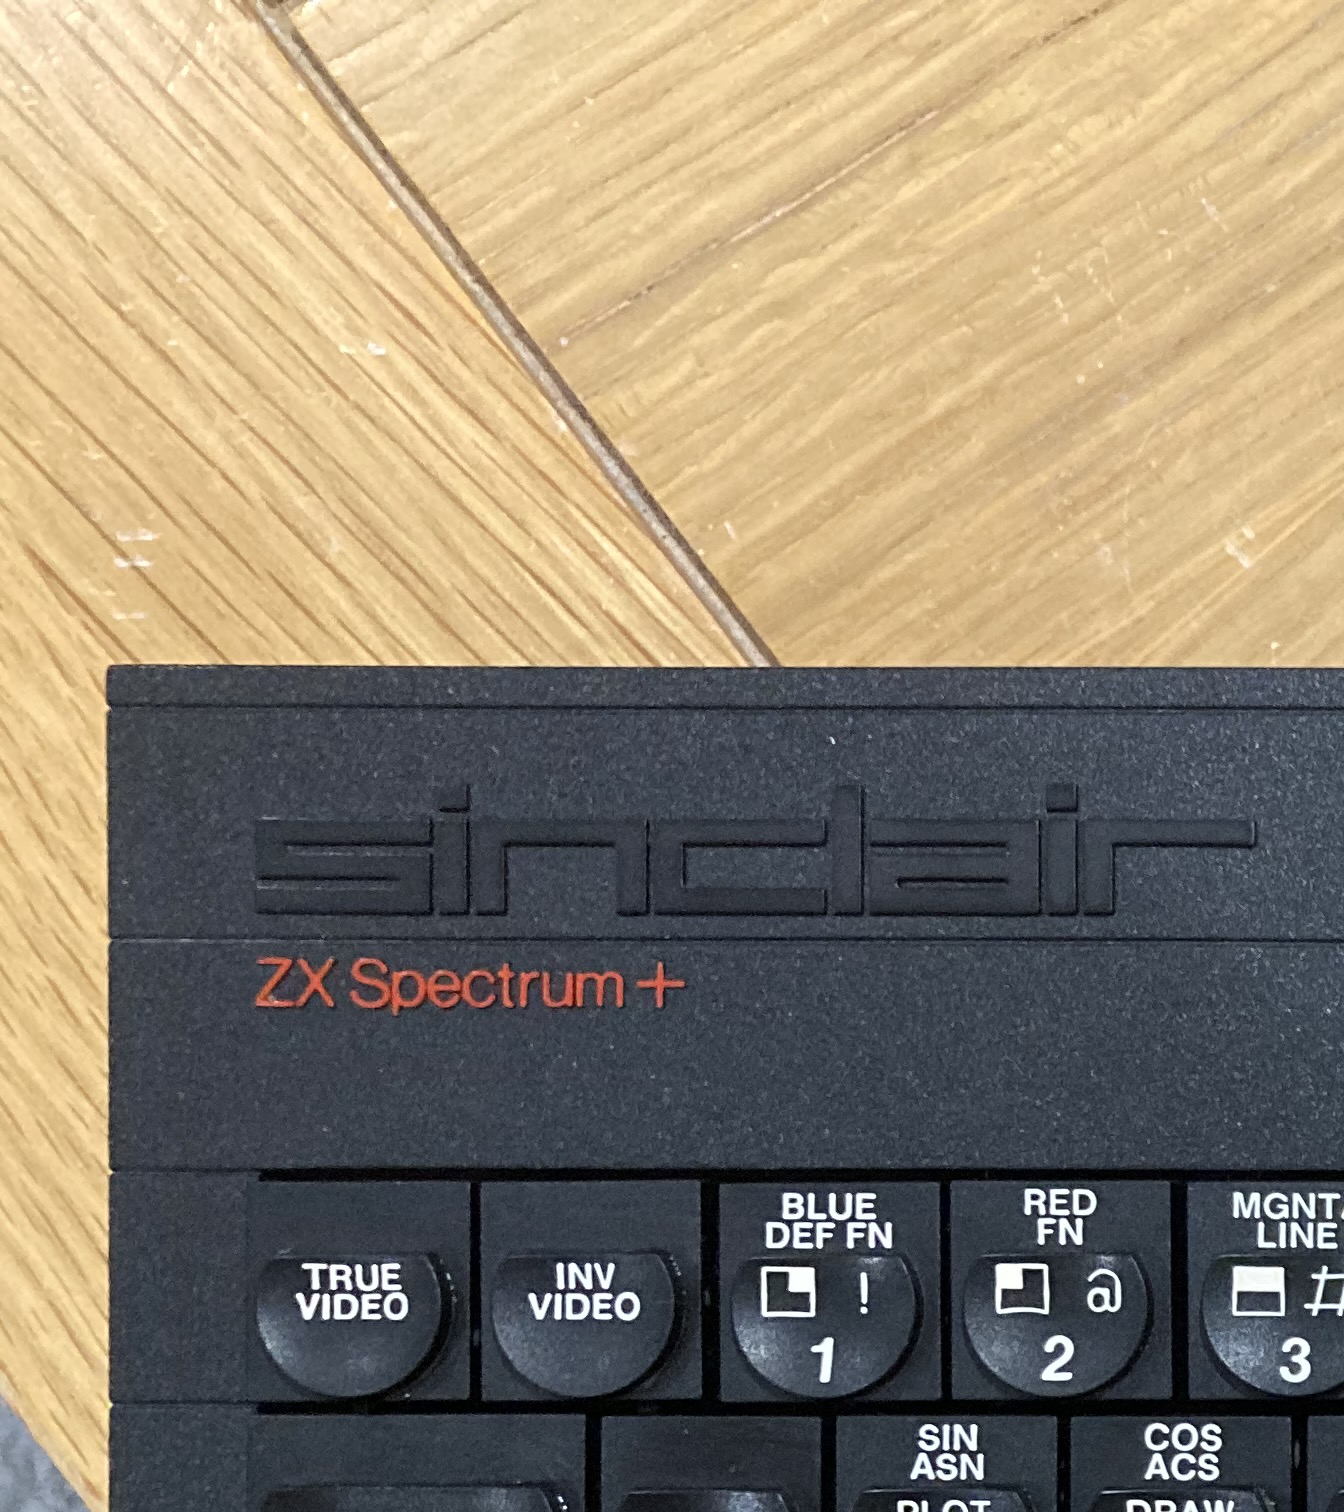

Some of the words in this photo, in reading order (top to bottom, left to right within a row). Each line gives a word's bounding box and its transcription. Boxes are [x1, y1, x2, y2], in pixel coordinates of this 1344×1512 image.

[253, 783, 1260, 918] sinclair
[254, 956, 335, 1009] ZX
[781, 1192, 877, 1221] BLUE
[1023, 1188, 1097, 1216] RED
[765, 1221, 836, 1250] DEF
[846, 1221, 893, 1250] FN
[1036, 1217, 1084, 1246] FN
[1257, 1221, 1339, 1250] LINE
[301, 1262, 403, 1292] TRUE
[555, 1262, 616, 1291] INV
[295, 1291, 409, 1321] VIDEO
[527, 1291, 641, 1322] VIDEO
[1040, 1334, 1075, 1382] 2
[1279, 1336, 1312, 1384] 3
[917, 1423, 978, 1452] SIN
[1144, 1422, 1223, 1452] COS
[909, 1452, 985, 1481] ASN
[1144, 1452, 1220, 1482] ACS
